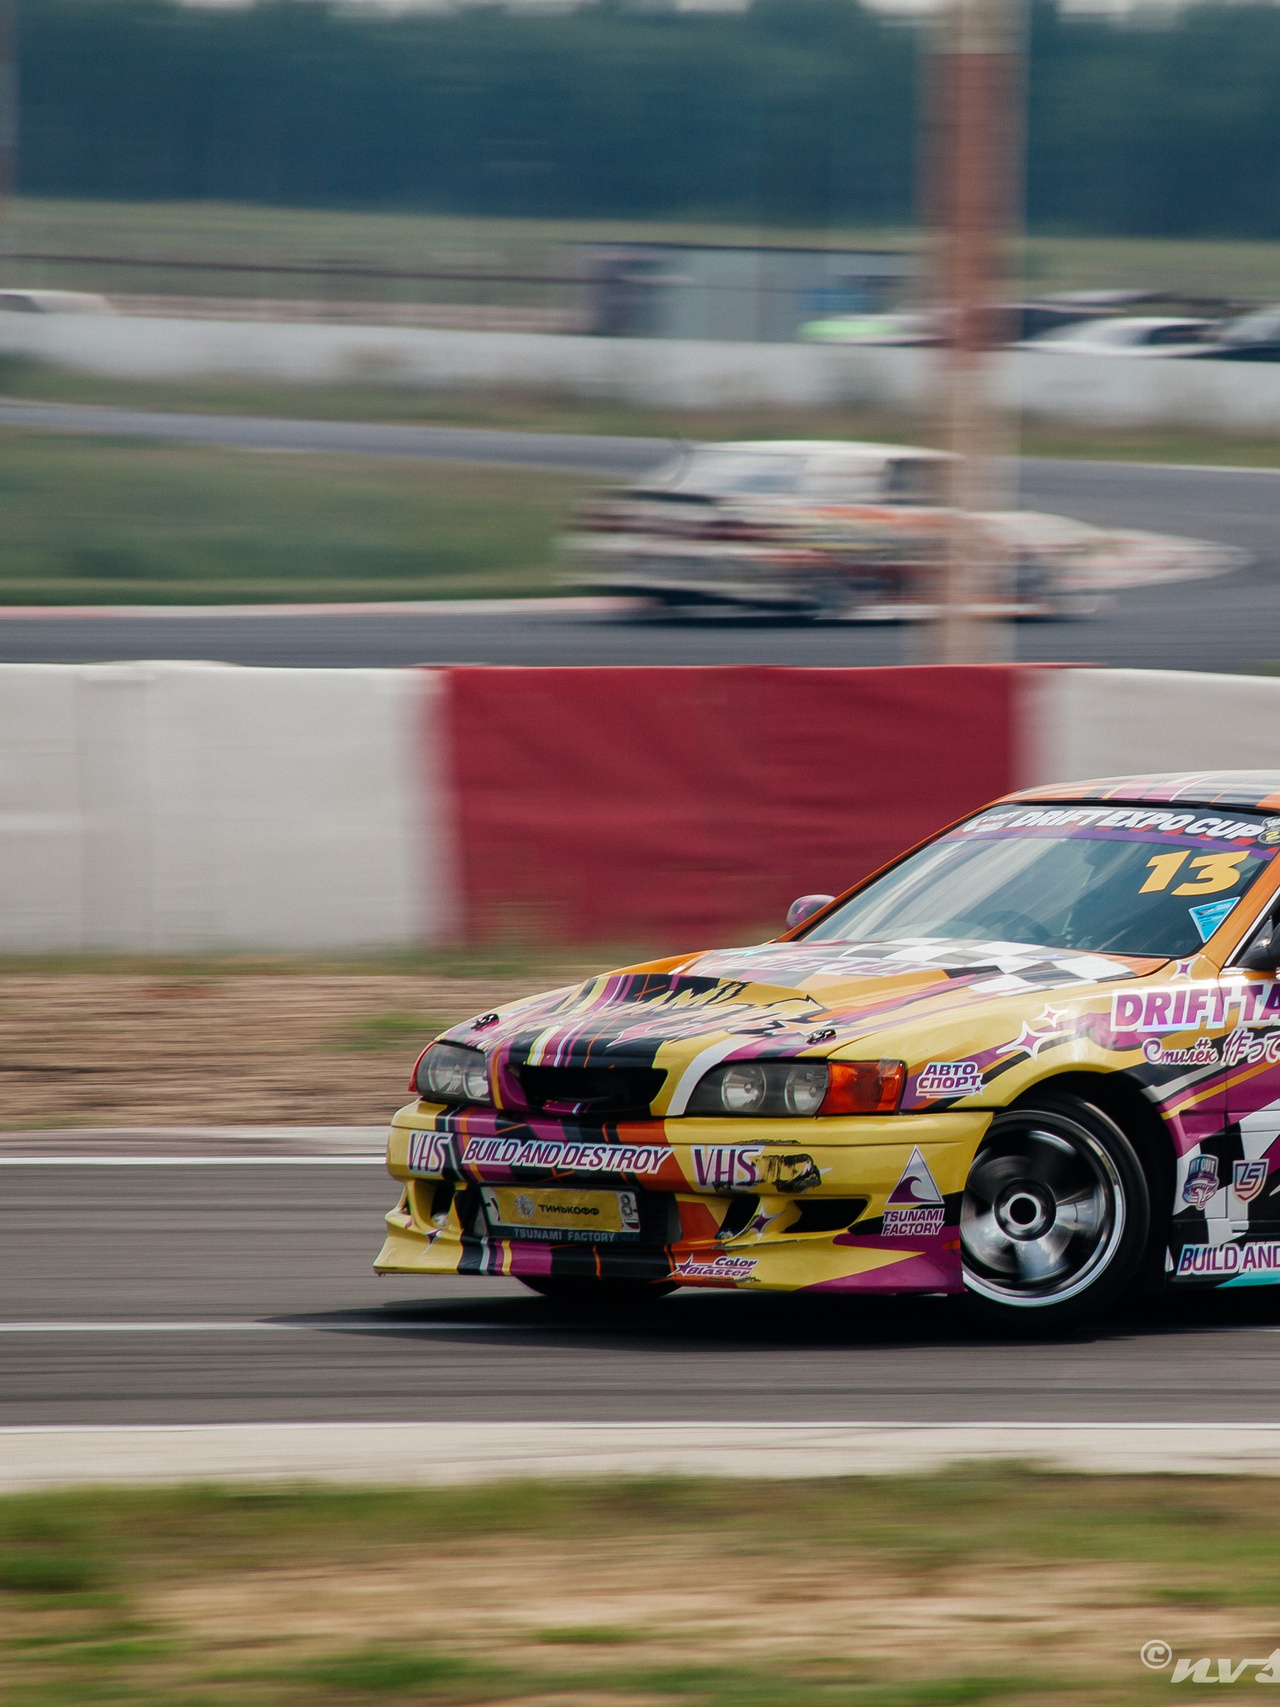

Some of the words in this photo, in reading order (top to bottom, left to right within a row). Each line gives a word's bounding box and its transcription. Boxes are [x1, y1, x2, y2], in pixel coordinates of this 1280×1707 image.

[1007, 810, 1112, 829] DRIFT
[1097, 812, 1197, 834] EXPO
[1184, 816, 1266, 840] CUP
[1139, 850, 1251, 896] 13
[1114, 986, 1233, 1028] DRIFT
[918, 1075, 981, 1090] СПОРТ
[924, 1063, 977, 1077] АВТО
[408, 1133, 451, 1173] VHS
[463, 1138, 518, 1163] BUILD
[515, 1140, 564, 1166] AND
[558, 1143, 673, 1173] DESTROY
[693, 1147, 762, 1187] VHS
[881, 1222, 943, 1236] FACTORY
[883, 1209, 945, 1223] TSUNAMI
[514, 1228, 562, 1241] TSUNAMI
[567, 1231, 615, 1243] FACTORY
[714, 1256, 758, 1268] Color
[1179, 1242, 1238, 1273] BUILD
